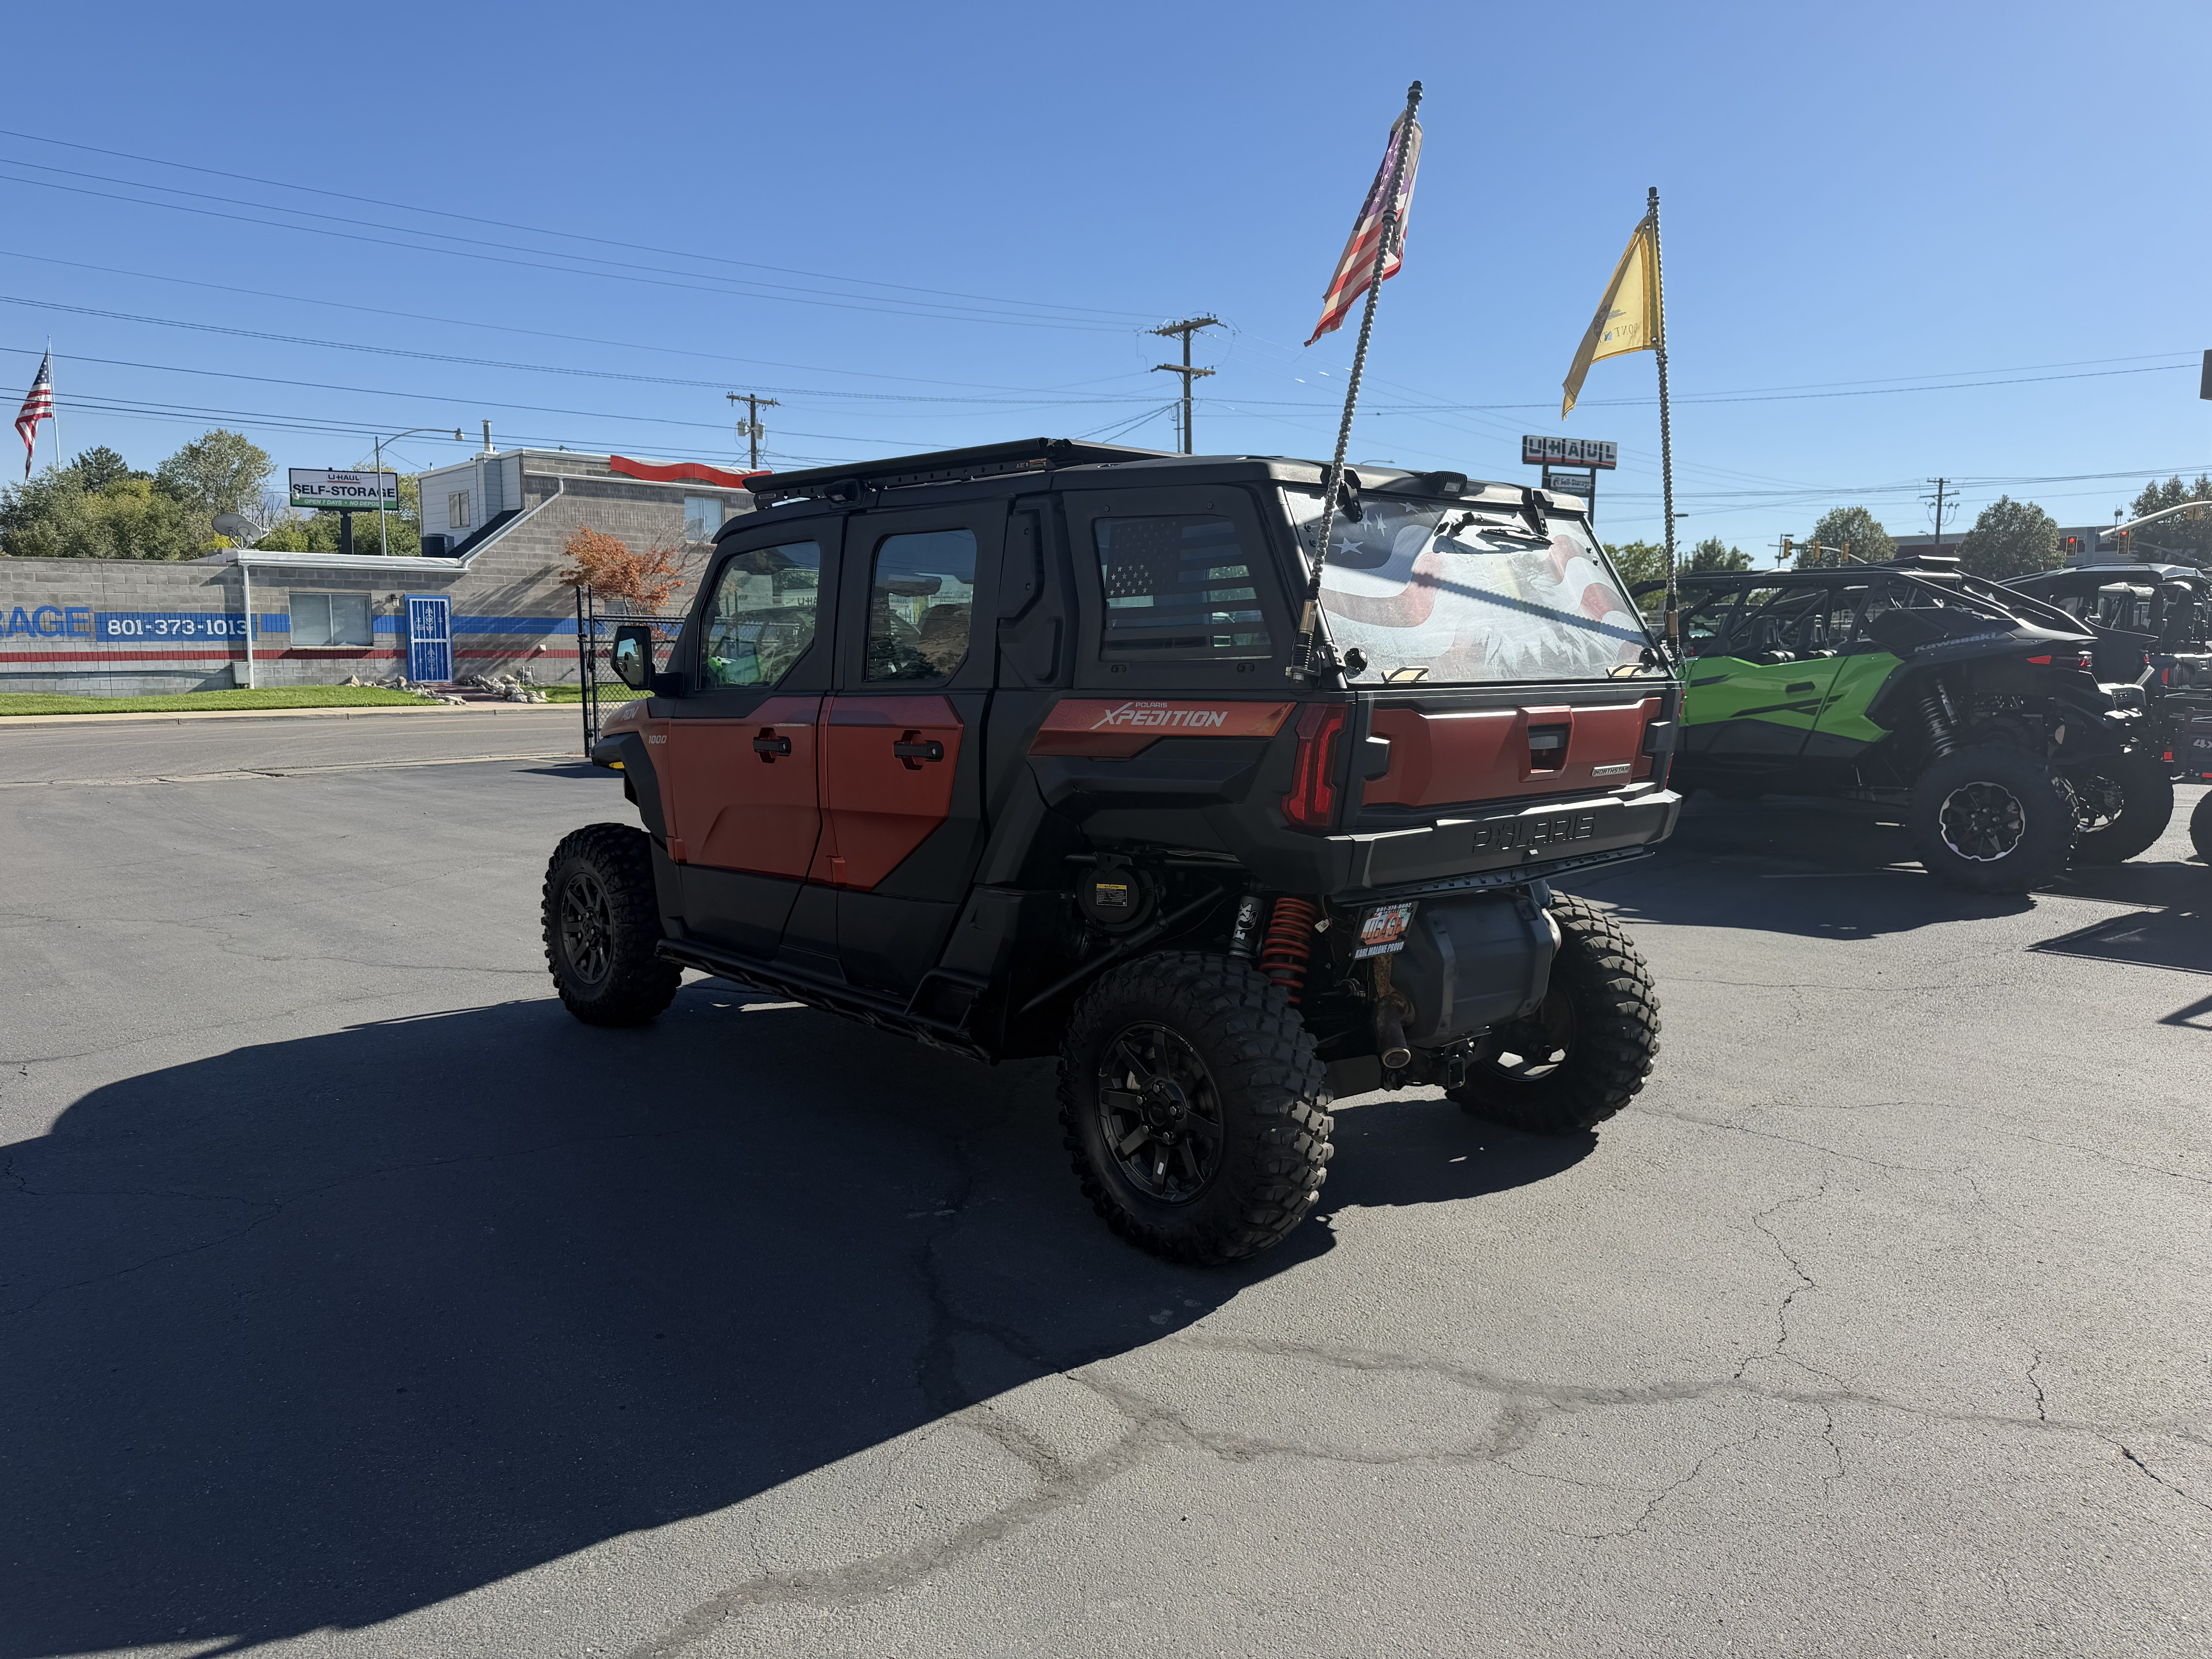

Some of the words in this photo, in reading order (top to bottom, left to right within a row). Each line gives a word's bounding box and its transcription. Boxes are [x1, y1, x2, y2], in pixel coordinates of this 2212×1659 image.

[293, 484, 395, 497] SELF-STORAGE
[108, 619, 247, 635] 801-373-1013
[1914, 632, 1996, 652] Kawasaki
[620, 706, 639, 722] ADV
[1089, 702, 1228, 730] XPEDITION
[649, 735, 667, 744] 1000
[1594, 766, 1629, 776] NORTHSTAR
[1472, 812, 1595, 853] POLARIS
[1355, 948, 1368, 958] KARL
[1368, 944, 1387, 956] MALONE
[1387, 941, 1404, 952] PROVO
